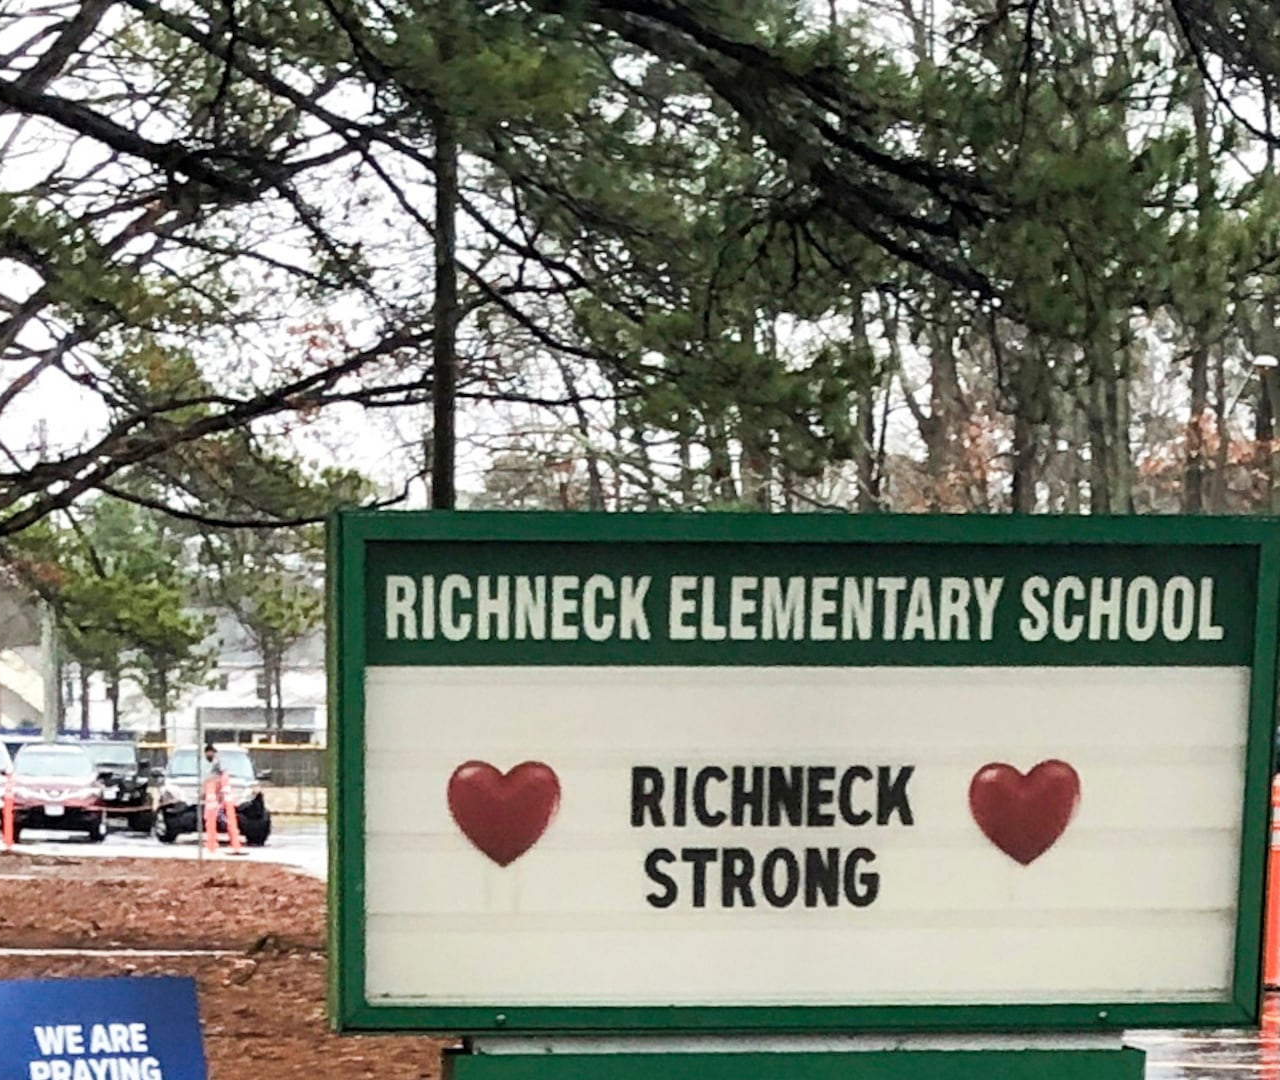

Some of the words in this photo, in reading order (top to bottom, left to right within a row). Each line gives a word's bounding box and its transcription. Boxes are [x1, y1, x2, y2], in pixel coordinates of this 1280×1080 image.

[386, 574, 651, 642] RICHNECK
[668, 575, 1004, 642] ELEMENTARY
[1019, 575, 1224, 642] SCHOOL
[630, 765, 915, 828] RICHNECK
[643, 847, 880, 909] STRONG
[33, 1024, 85, 1055] WE
[90, 1022, 149, 1054] ARE
